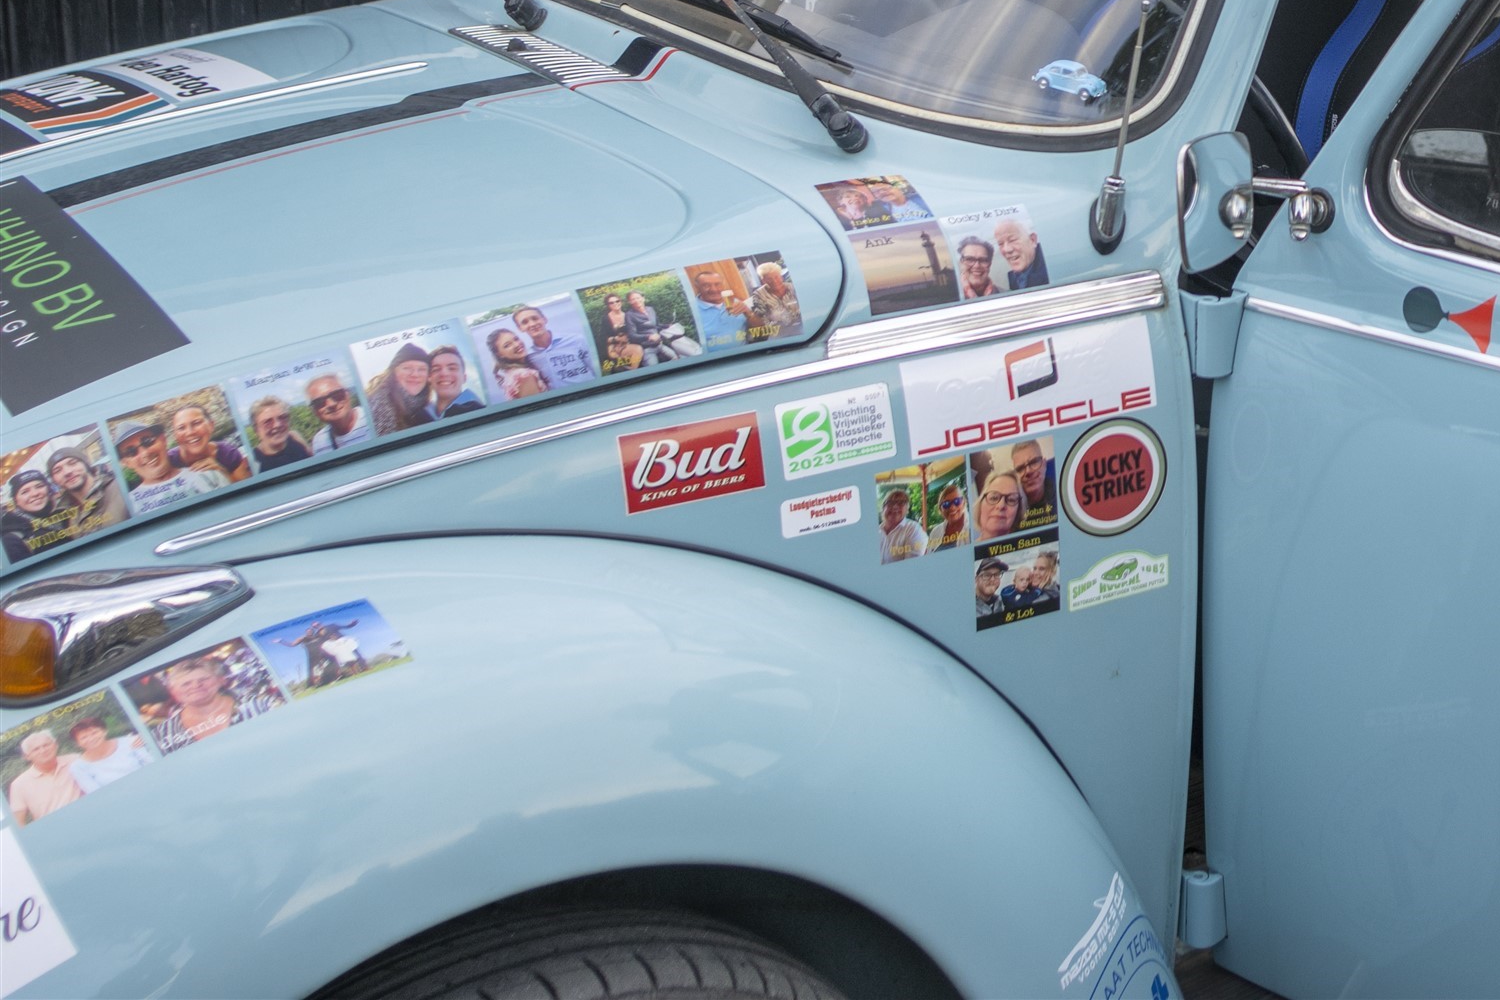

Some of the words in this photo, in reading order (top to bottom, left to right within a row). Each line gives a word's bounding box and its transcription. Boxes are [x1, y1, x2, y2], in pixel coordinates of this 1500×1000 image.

[983, 210, 993, 219] &
[865, 236, 896, 249] Ank
[32, 282, 116, 331] BV
[748, 323, 781, 340] Willy
[832, 404, 876, 421] Stichting
[833, 412, 883, 429] Vrijwillige
[918, 386, 1151, 456] JOBACLE
[835, 420, 886, 439] Klassieker
[836, 432, 883, 449] Inspectie
[631, 426, 751, 490] Bud
[789, 453, 836, 473] 2023
[1083, 447, 1144, 483] LUCKY
[640, 487, 677, 503] KING
[680, 482, 701, 495] OF
[703, 473, 746, 490] BEERS
[1081, 470, 1147, 506] STRIKE
[1017, 537, 1041, 550] Sam
[1005, 611, 1016, 622] &
[1017, 607, 1035, 619] Lot
